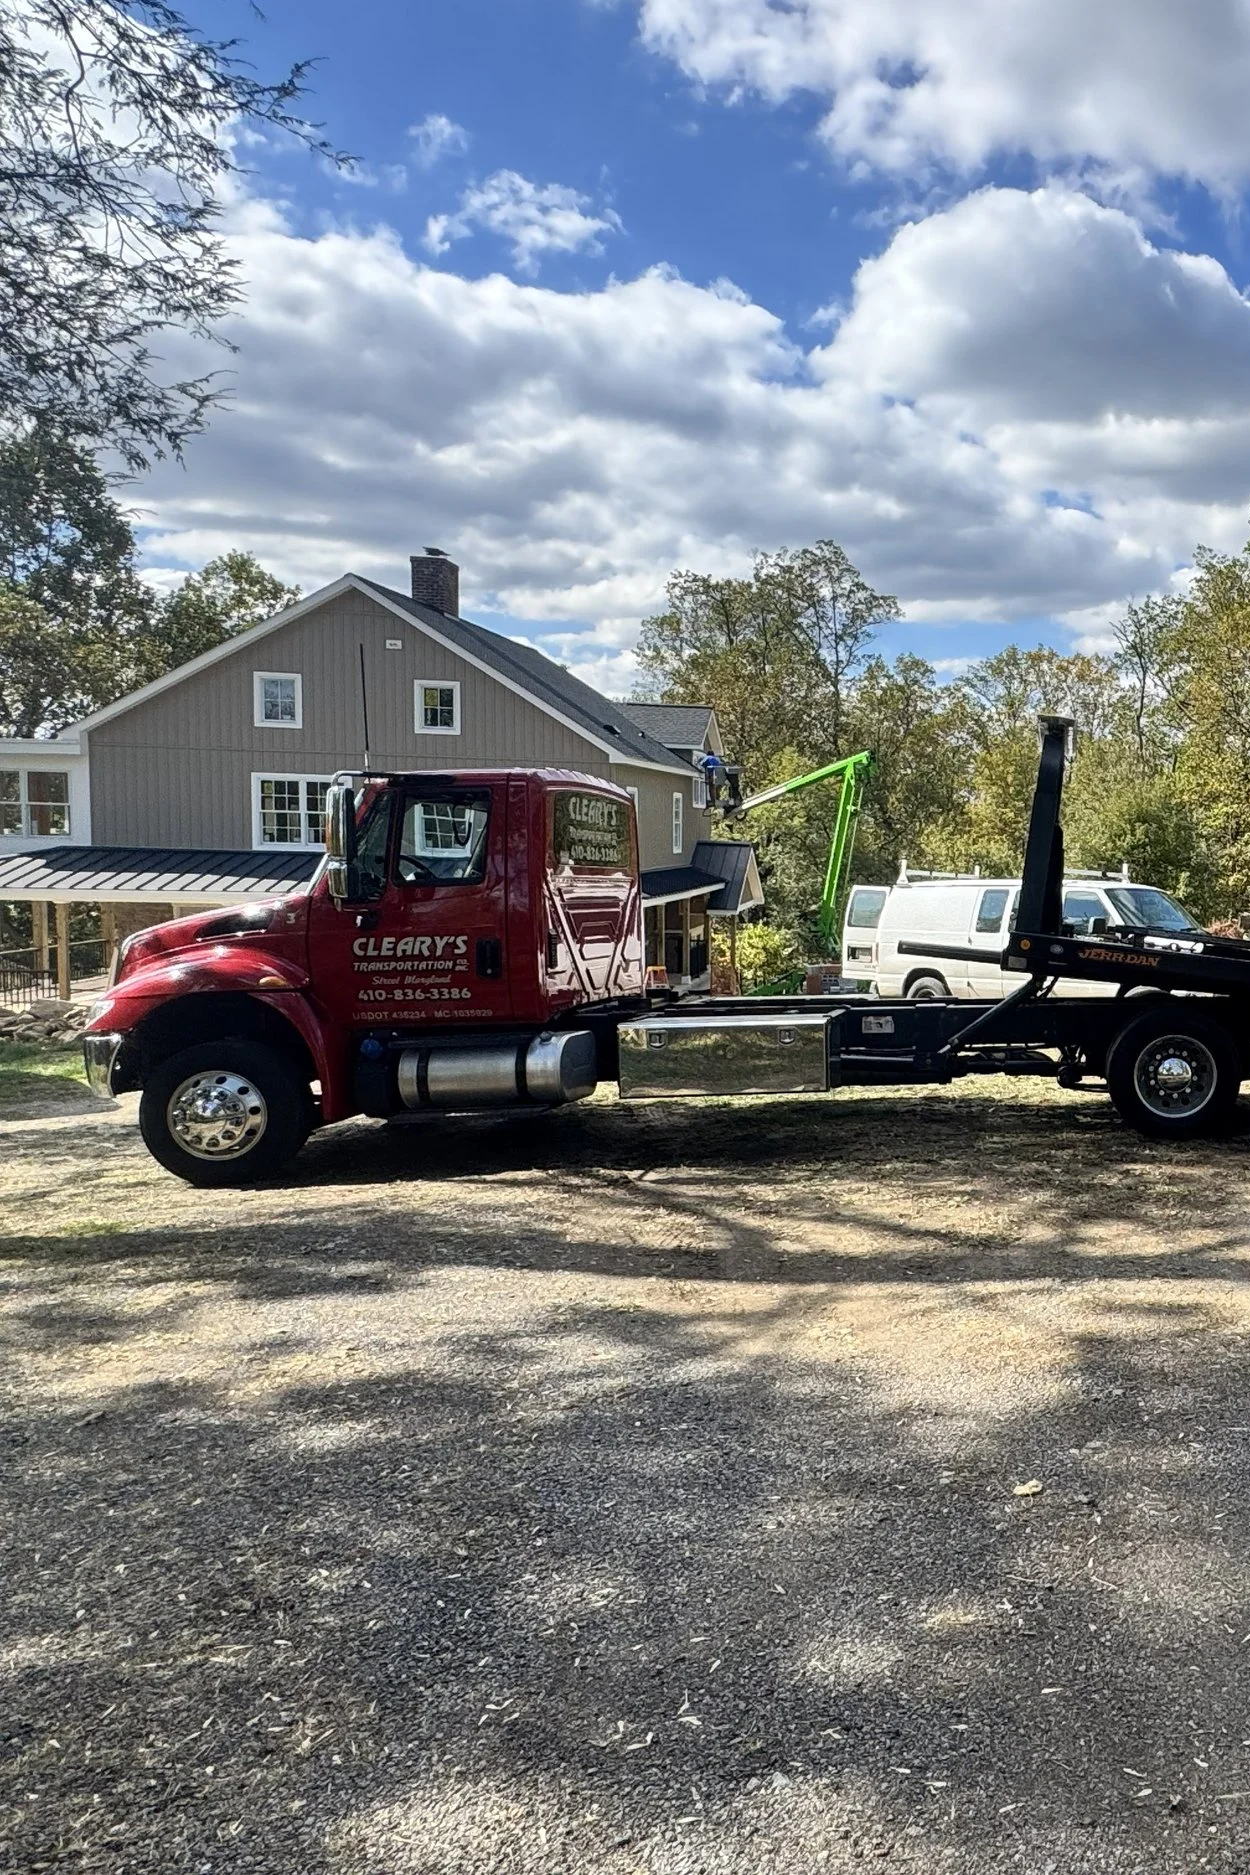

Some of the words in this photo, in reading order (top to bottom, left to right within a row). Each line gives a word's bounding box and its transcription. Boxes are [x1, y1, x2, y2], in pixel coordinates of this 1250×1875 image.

[569, 797, 617, 828] CLEARY'S
[353, 936, 468, 957] CLEARY'S
[353, 960, 453, 972] TRANSPORTATION
[404, 974, 452, 986] Maryland
[358, 987, 471, 1001] 410-836-3386
[352, 1012, 389, 1020] USDOT
[434, 1010, 450, 1019] MC
